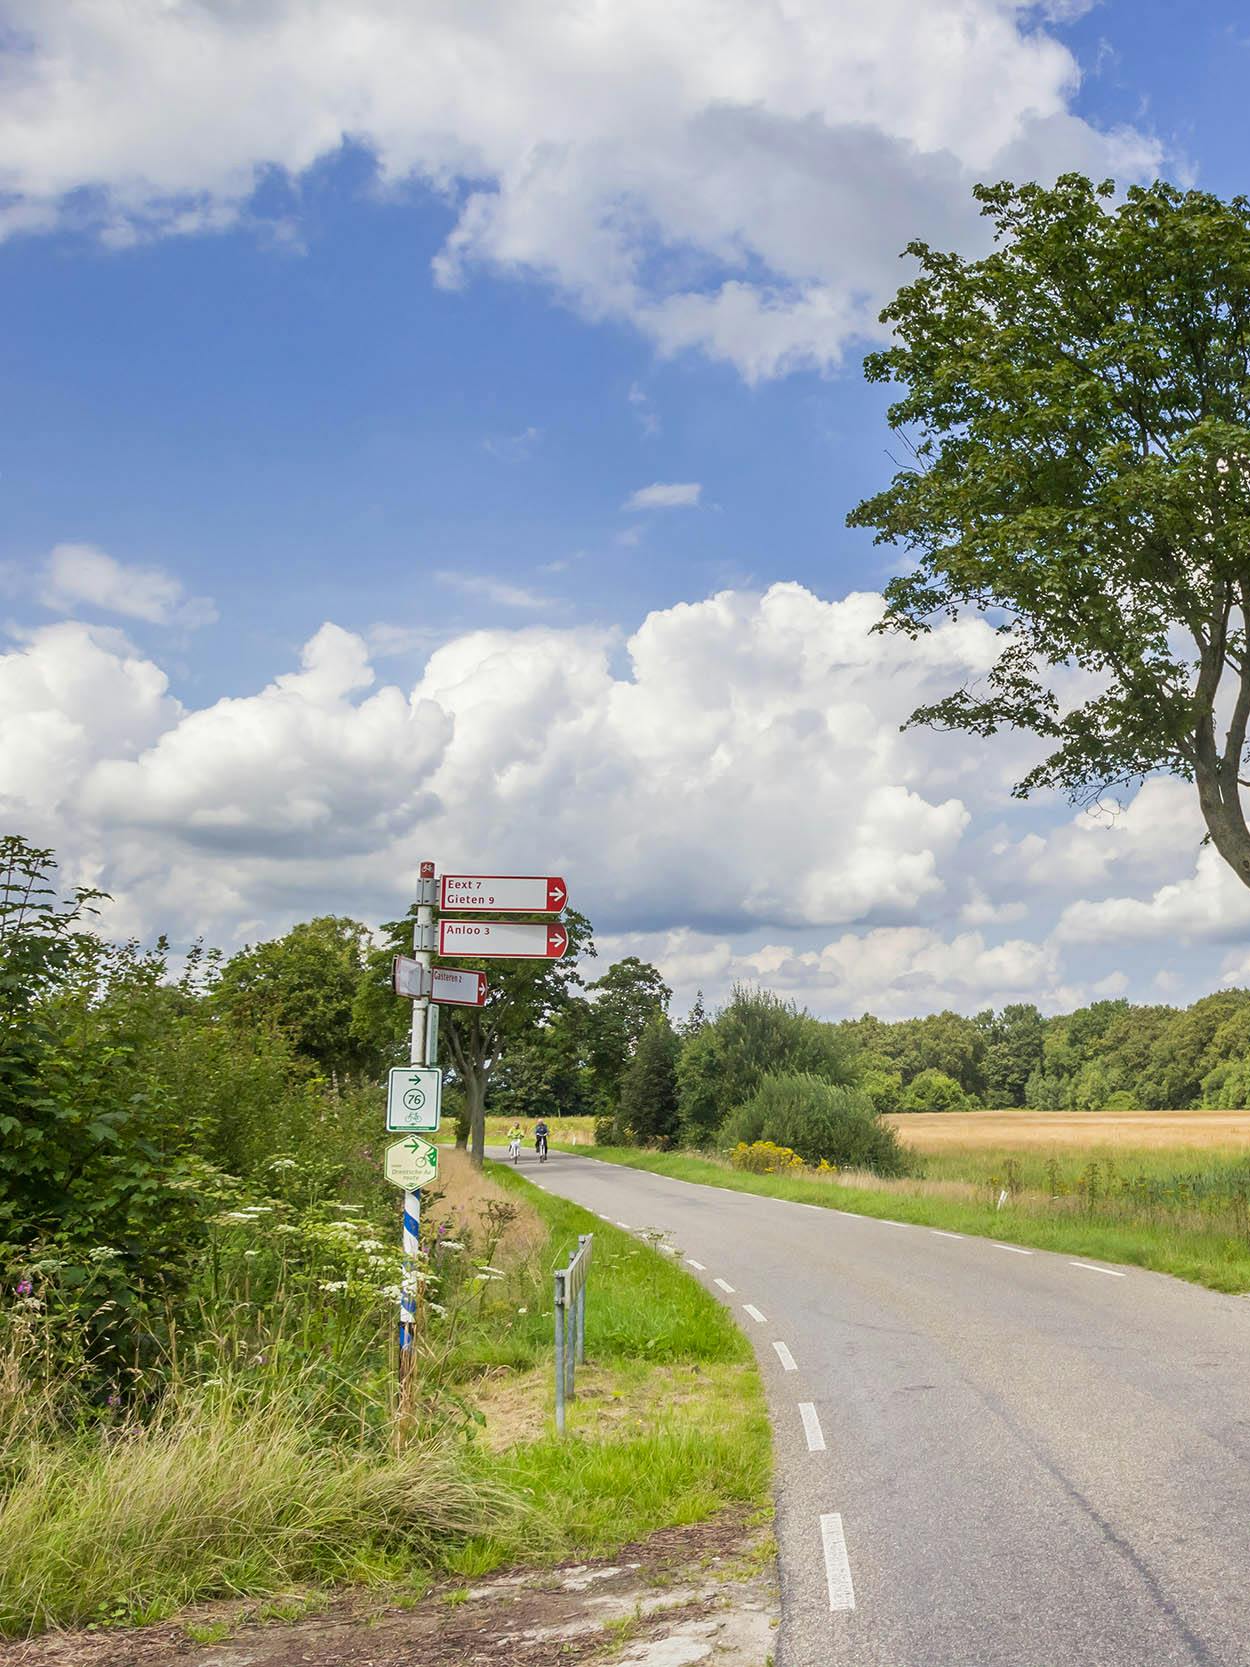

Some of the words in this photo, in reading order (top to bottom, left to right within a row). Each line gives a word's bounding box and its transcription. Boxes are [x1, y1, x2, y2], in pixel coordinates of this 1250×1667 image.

[448, 880, 473, 889] Eext
[476, 881, 481, 889] 7
[447, 895, 485, 904] Gieten
[489, 896, 495, 904] 9
[446, 925, 481, 935] Anloo
[484, 927, 490, 935] 3
[408, 1094, 421, 1104] 76
